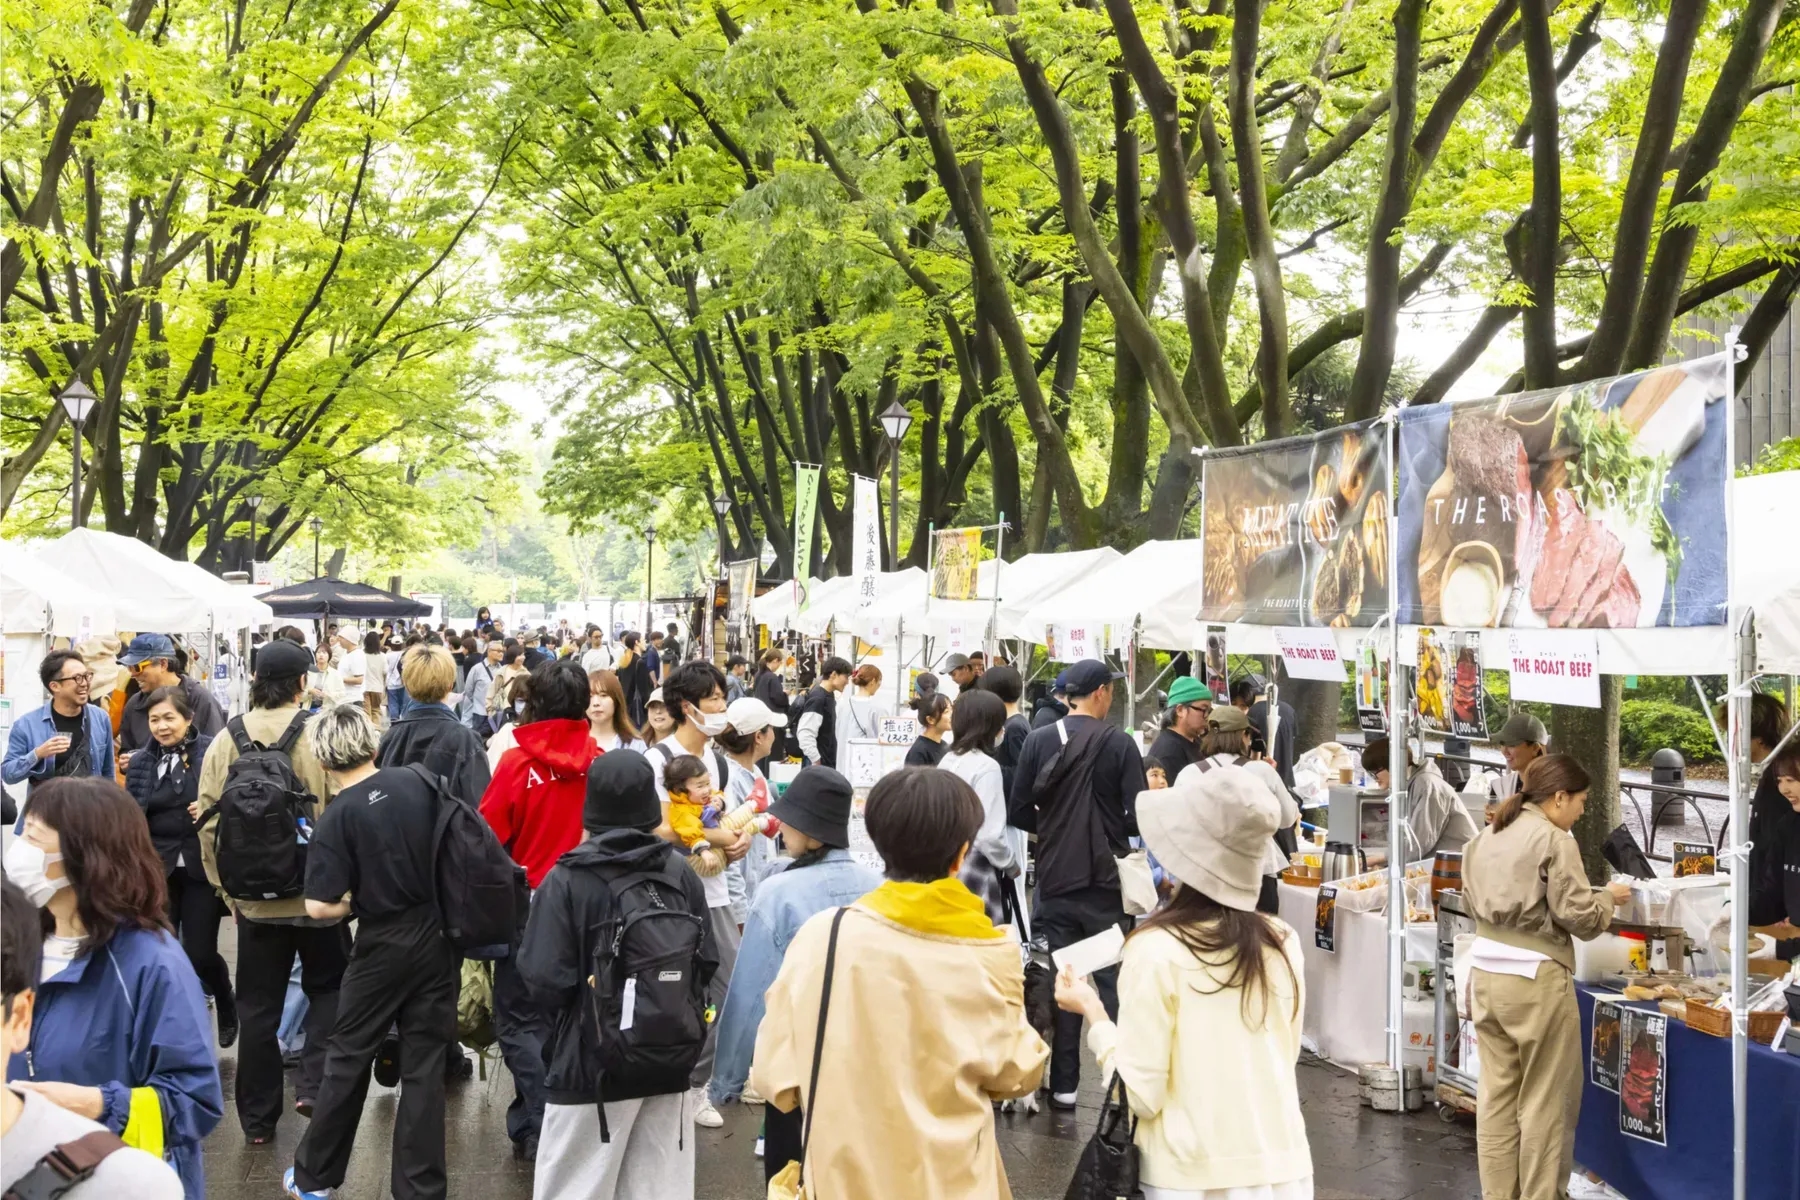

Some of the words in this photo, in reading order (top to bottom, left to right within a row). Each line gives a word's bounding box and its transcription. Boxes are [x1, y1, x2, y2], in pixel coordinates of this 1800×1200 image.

[1434, 496, 1486, 526] THE
[1501, 484, 1587, 523] ROAST
[1242, 502, 1299, 548] MEAT
[1282, 647, 1296, 659] THE
[1296, 648, 1319, 660] ROAST
[1319, 649, 1336, 661] BEEF
[1513, 657, 1530, 674] THE
[1534, 659, 1565, 676] ROAST
[1569, 661, 1592, 678] BEEF
[884, 720, 914, 733] 推し活
[1654, 1041, 1664, 1135] ローストビーフ
[1621, 1114, 1643, 1132] 1,000
